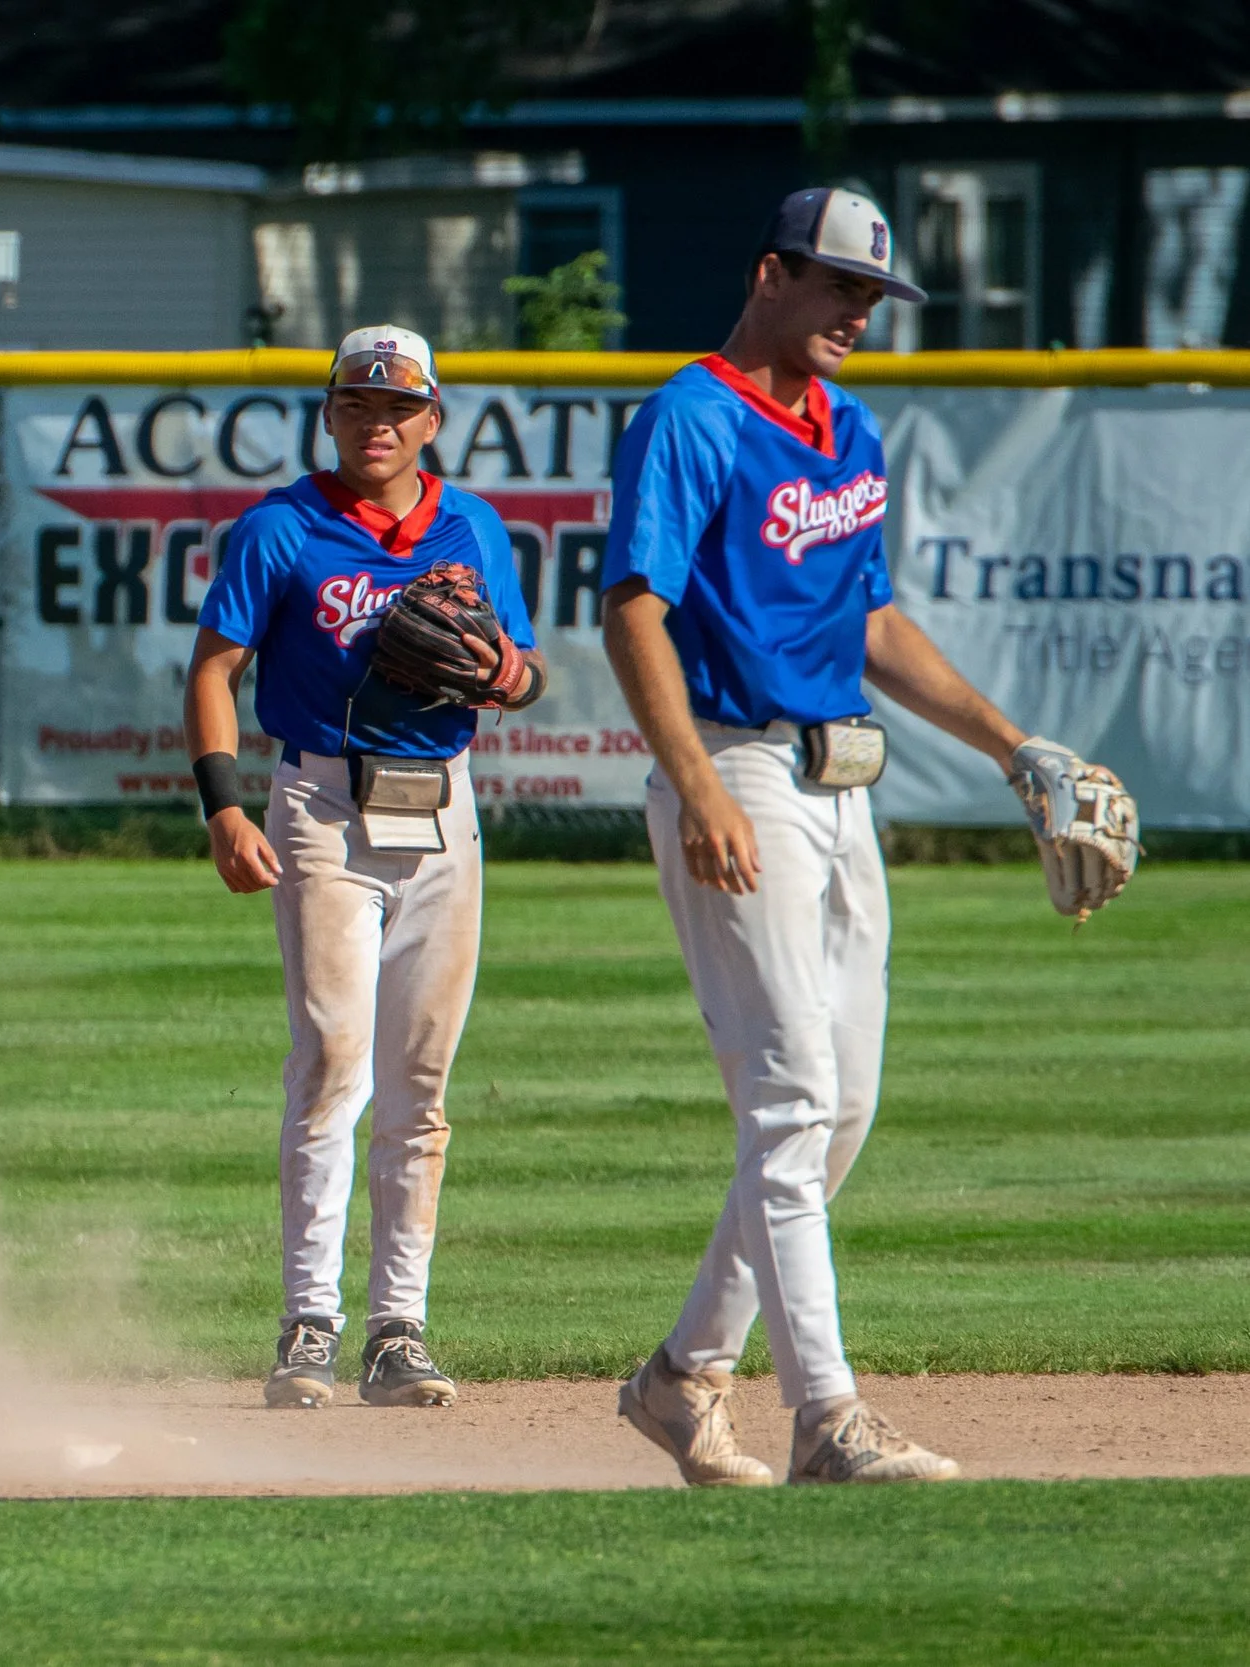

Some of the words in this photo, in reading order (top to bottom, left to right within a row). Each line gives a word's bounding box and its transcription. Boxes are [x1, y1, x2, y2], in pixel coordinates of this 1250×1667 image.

[915, 535, 1250, 601] Transna
[1136, 625, 1250, 690] Age
[507, 725, 591, 756] Since
[599, 728, 648, 756] 200
